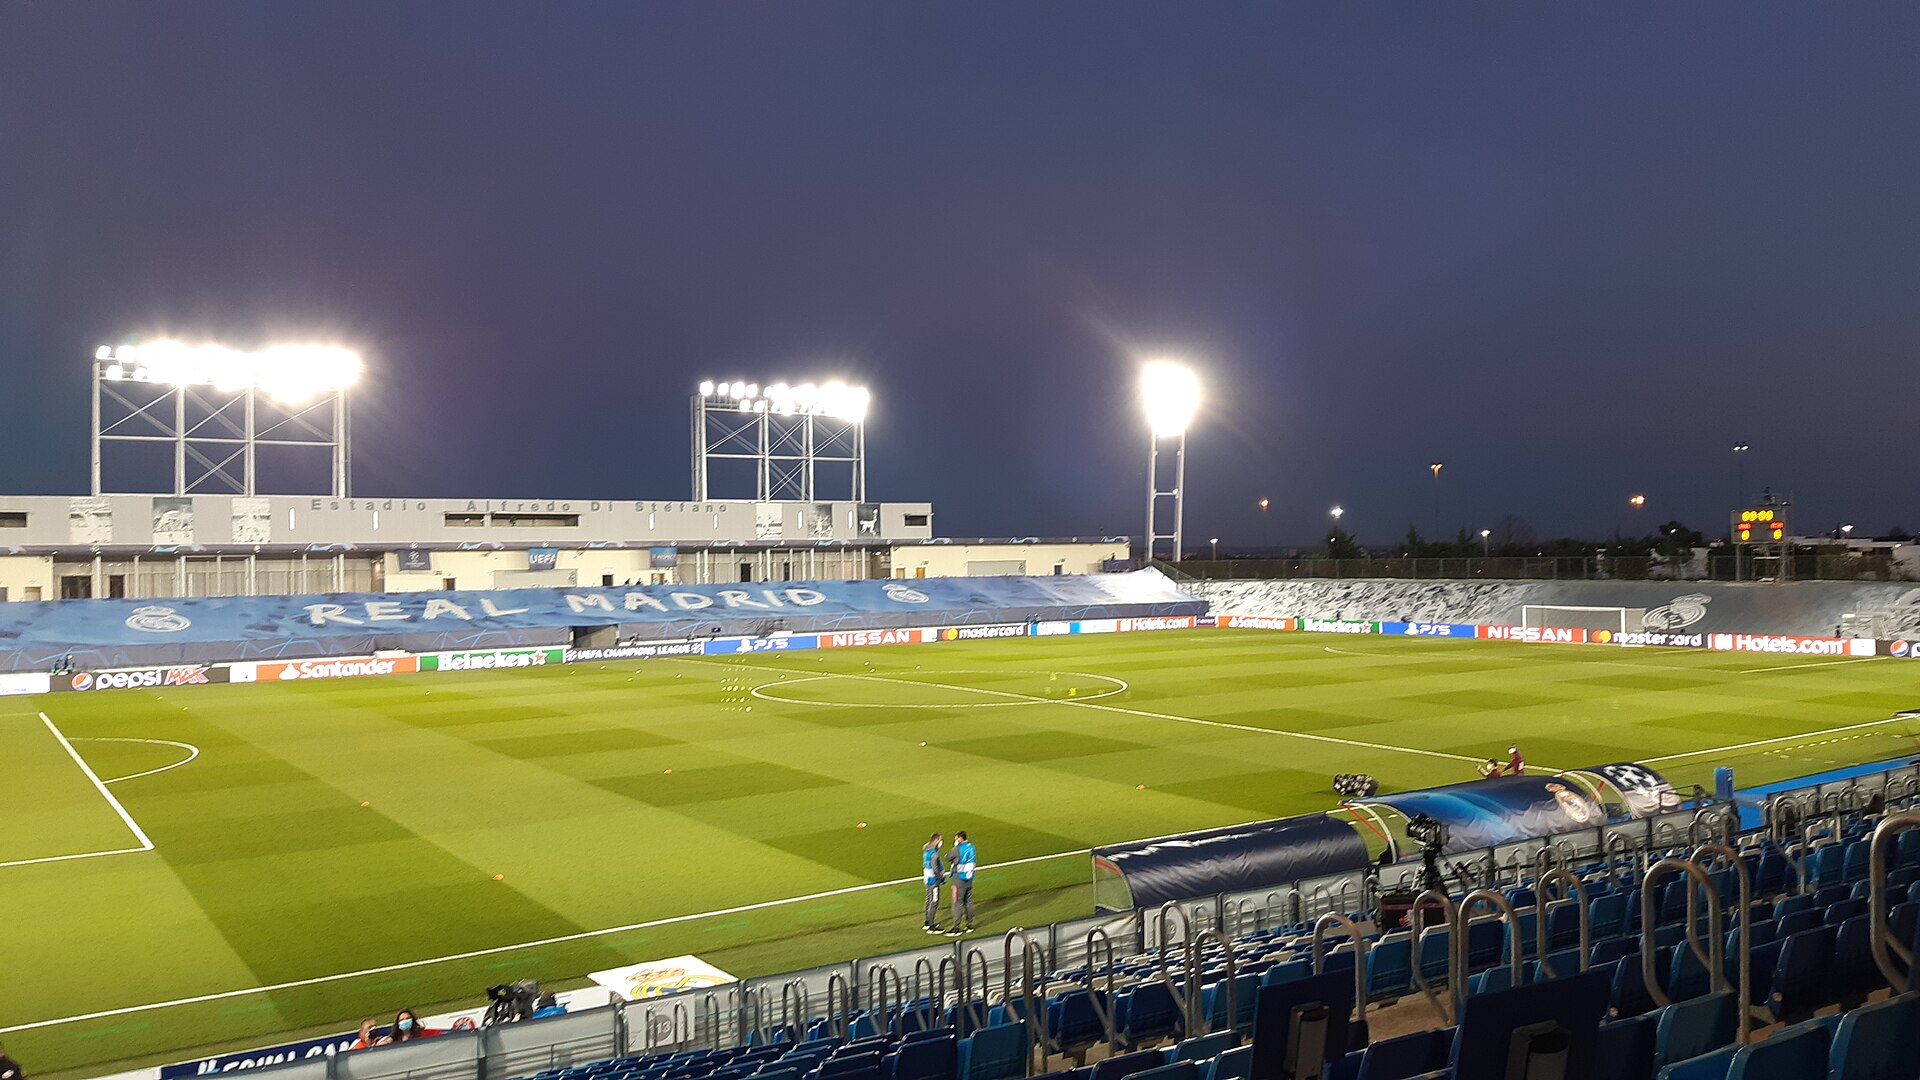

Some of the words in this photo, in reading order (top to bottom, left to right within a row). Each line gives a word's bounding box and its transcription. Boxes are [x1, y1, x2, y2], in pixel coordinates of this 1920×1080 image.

[311, 499, 426, 511] Estadio
[465, 500, 570, 513] Alfredo
[590, 500, 613, 512] Di
[634, 500, 728, 513] Stéfano
[529, 554, 556, 564] UEFA
[303, 598, 530, 625] REAL
[563, 588, 827, 613] MADRID
[959, 623, 1025, 639] mastercard
[1131, 616, 1192, 632] Hotels.com
[1237, 616, 1287, 630] Santander
[1419, 624, 1451, 635] PS5
[832, 630, 911, 647] NISSAN
[1487, 626, 1573, 643] NISSAN
[578, 648, 601, 660] UEFA
[603, 646, 657, 659] CHAMPIONS
[657, 643, 692, 656] LEAGUE
[754, 638, 790, 650] PS5
[1736, 633, 1844, 655] Hotels.com
[299, 658, 396, 679] Santander
[436, 651, 531, 671] Heineken
[95, 669, 163, 691] pepsi
